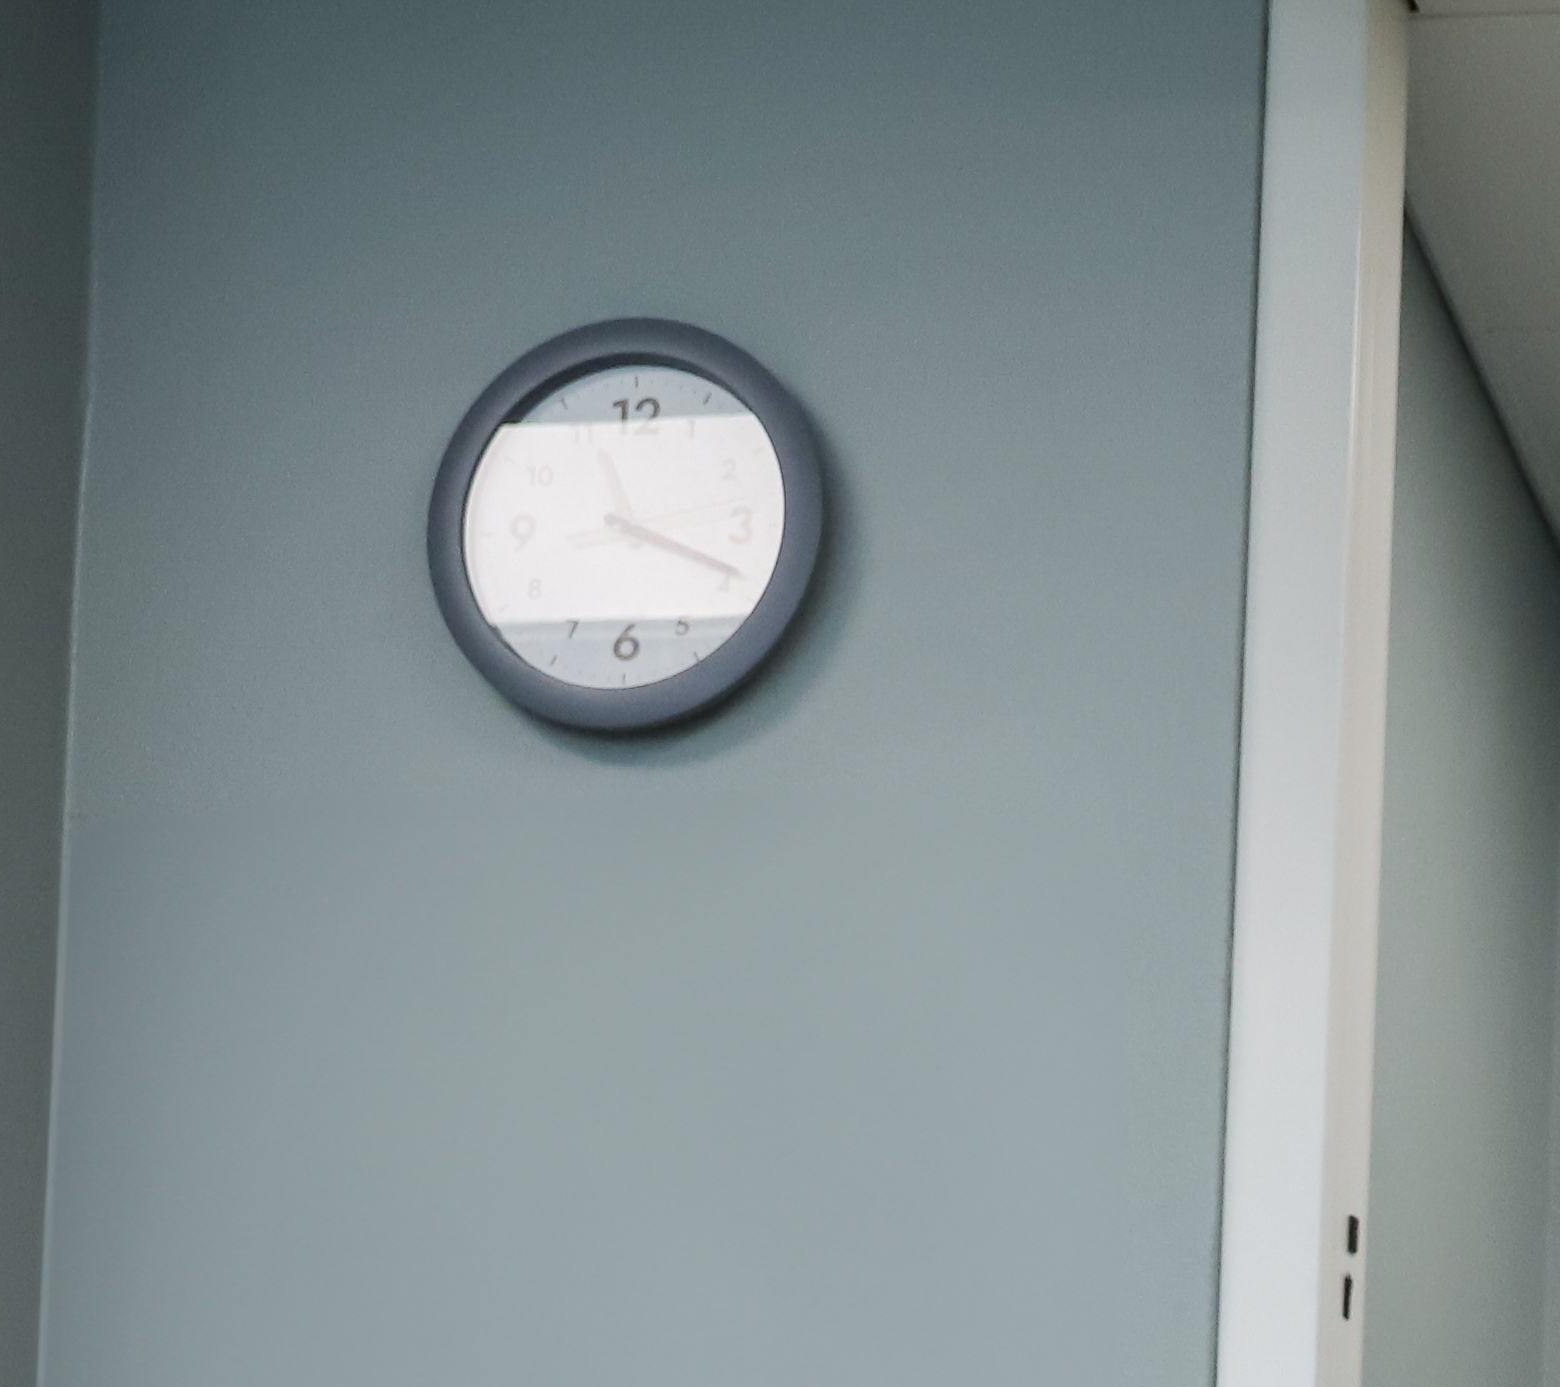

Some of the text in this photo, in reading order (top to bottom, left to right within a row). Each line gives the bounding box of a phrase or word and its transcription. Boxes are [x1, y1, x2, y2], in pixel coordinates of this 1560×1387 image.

[612, 397, 661, 436] 12
[527, 465, 555, 487] 10
[722, 459, 737, 481] 2
[509, 513, 537, 552] 9
[728, 506, 754, 545] 3
[527, 577, 542, 600] 8
[567, 619, 580, 639] 7
[675, 616, 690, 636] 5
[612, 623, 640, 662] 6
